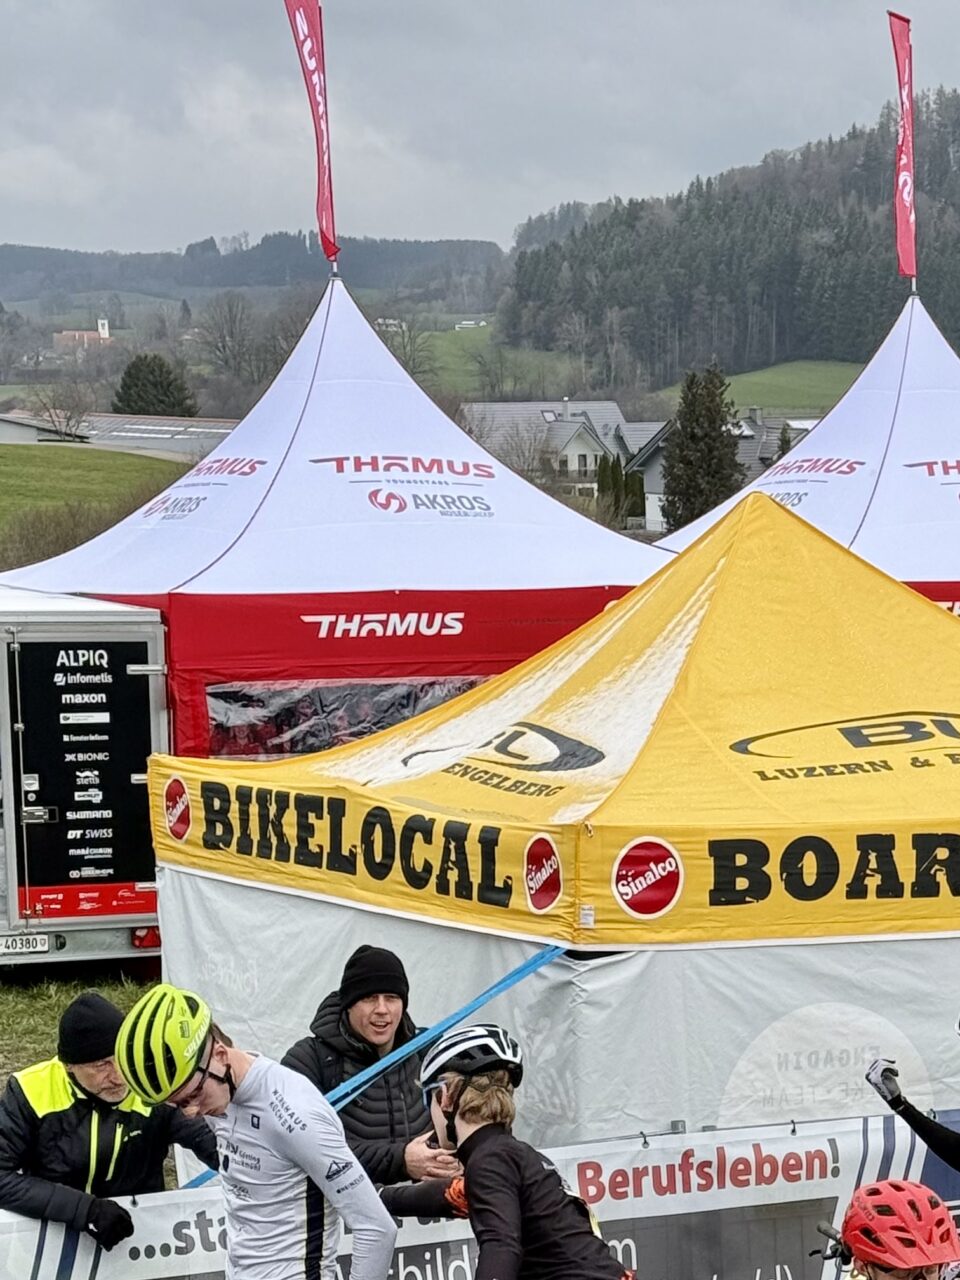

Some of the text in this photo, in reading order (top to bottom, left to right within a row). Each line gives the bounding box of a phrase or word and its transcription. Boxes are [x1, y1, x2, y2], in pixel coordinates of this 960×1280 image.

[412, 493, 492, 512] AKROS
[56, 649, 108, 668] ALPIQ
[67, 672, 113, 684] infometis
[62, 692, 106, 704] maxon
[78, 752, 110, 762] BIONIC
[442, 762, 564, 797] ENGELBERG
[753, 759, 893, 781] LUZERN
[909, 756, 936, 768] &
[66, 810, 112, 819] SHIMANO
[168, 792, 190, 826] Sinalco
[67, 828, 113, 839] DT SWISS
[201, 781, 512, 908] BIKELOCAL
[526, 855, 558, 896] Sinalco
[617, 856, 679, 901] Sinalco
[577, 1138, 841, 1204] Berufsleben!
